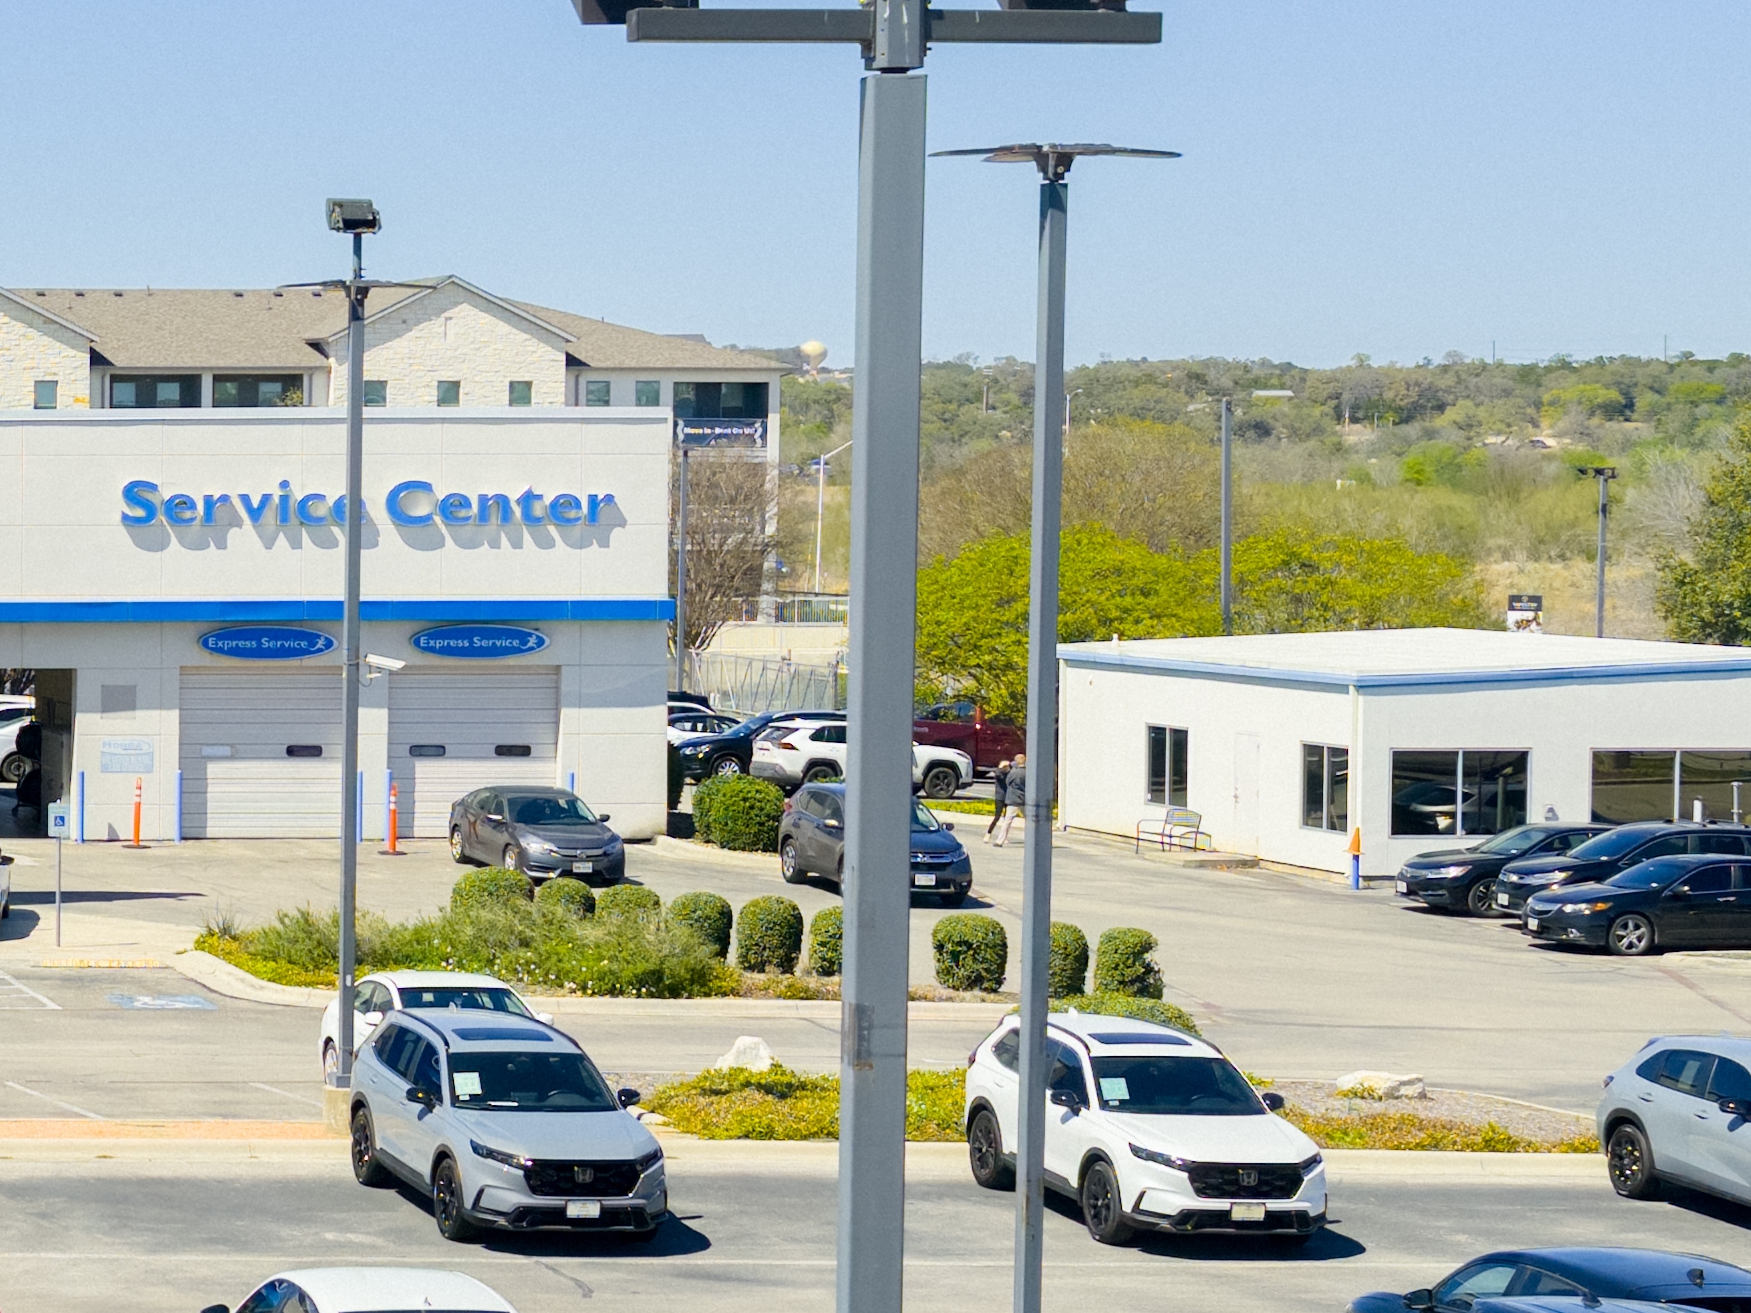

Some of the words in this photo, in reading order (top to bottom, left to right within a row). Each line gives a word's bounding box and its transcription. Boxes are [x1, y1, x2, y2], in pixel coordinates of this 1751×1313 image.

[120, 479, 367, 527] Service
[385, 480, 617, 527] Center
[208, 637, 257, 650] Express
[260, 637, 308, 648] Service
[420, 636, 469, 649] Express
[473, 636, 519, 647] Service
